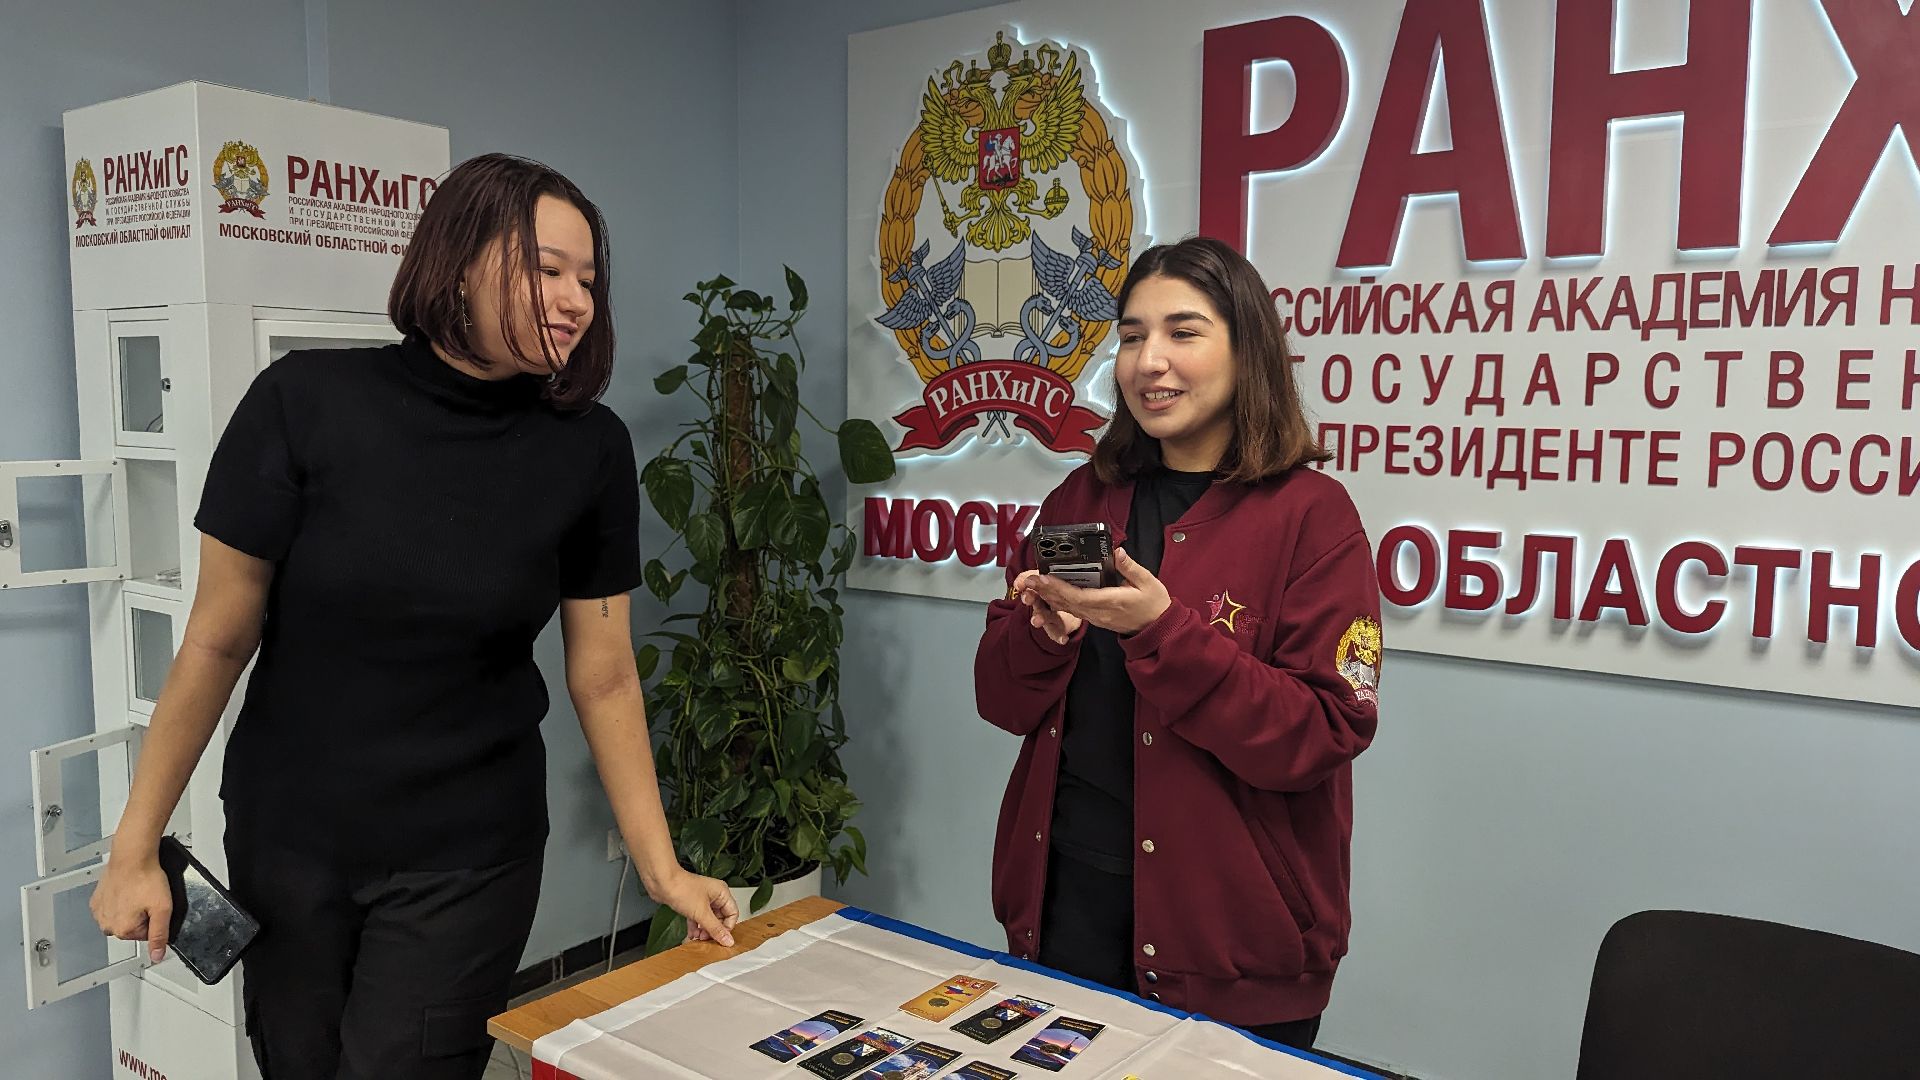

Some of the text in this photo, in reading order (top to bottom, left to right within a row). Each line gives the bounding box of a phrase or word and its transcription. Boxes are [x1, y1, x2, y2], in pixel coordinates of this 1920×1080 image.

[103, 144, 189, 195] РАНХиГС
[288, 195, 332, 210] РОССИЙСКАЯ
[332, 201, 368, 214] АКАДЕМИЯ
[288, 206, 295, 215] И
[300, 208, 397, 228] ГОСУДАРСТВЕННОЙ
[75, 223, 191, 248] МОСКОВСКИЙ ОБЛАСТНОЙ ФИЛИАЛ
[219, 222, 409, 257] МОСКОВСКИЙ ОБЛАСТНОЙ ФИ
[289, 216, 305, 227] ПРИ
[306, 219, 353, 233] ПРЕЗИДЕНТЕ
[353, 225, 400, 238] РОССИЙСКОЙ
[1527, 266, 1859, 341] АКАДЕМИЯ
[928, 369, 1069, 419] РАНХиГС
[1316, 422, 1681, 491] ПРЕЗИДЕНТЕ
[864, 496, 1040, 568] МОСК
